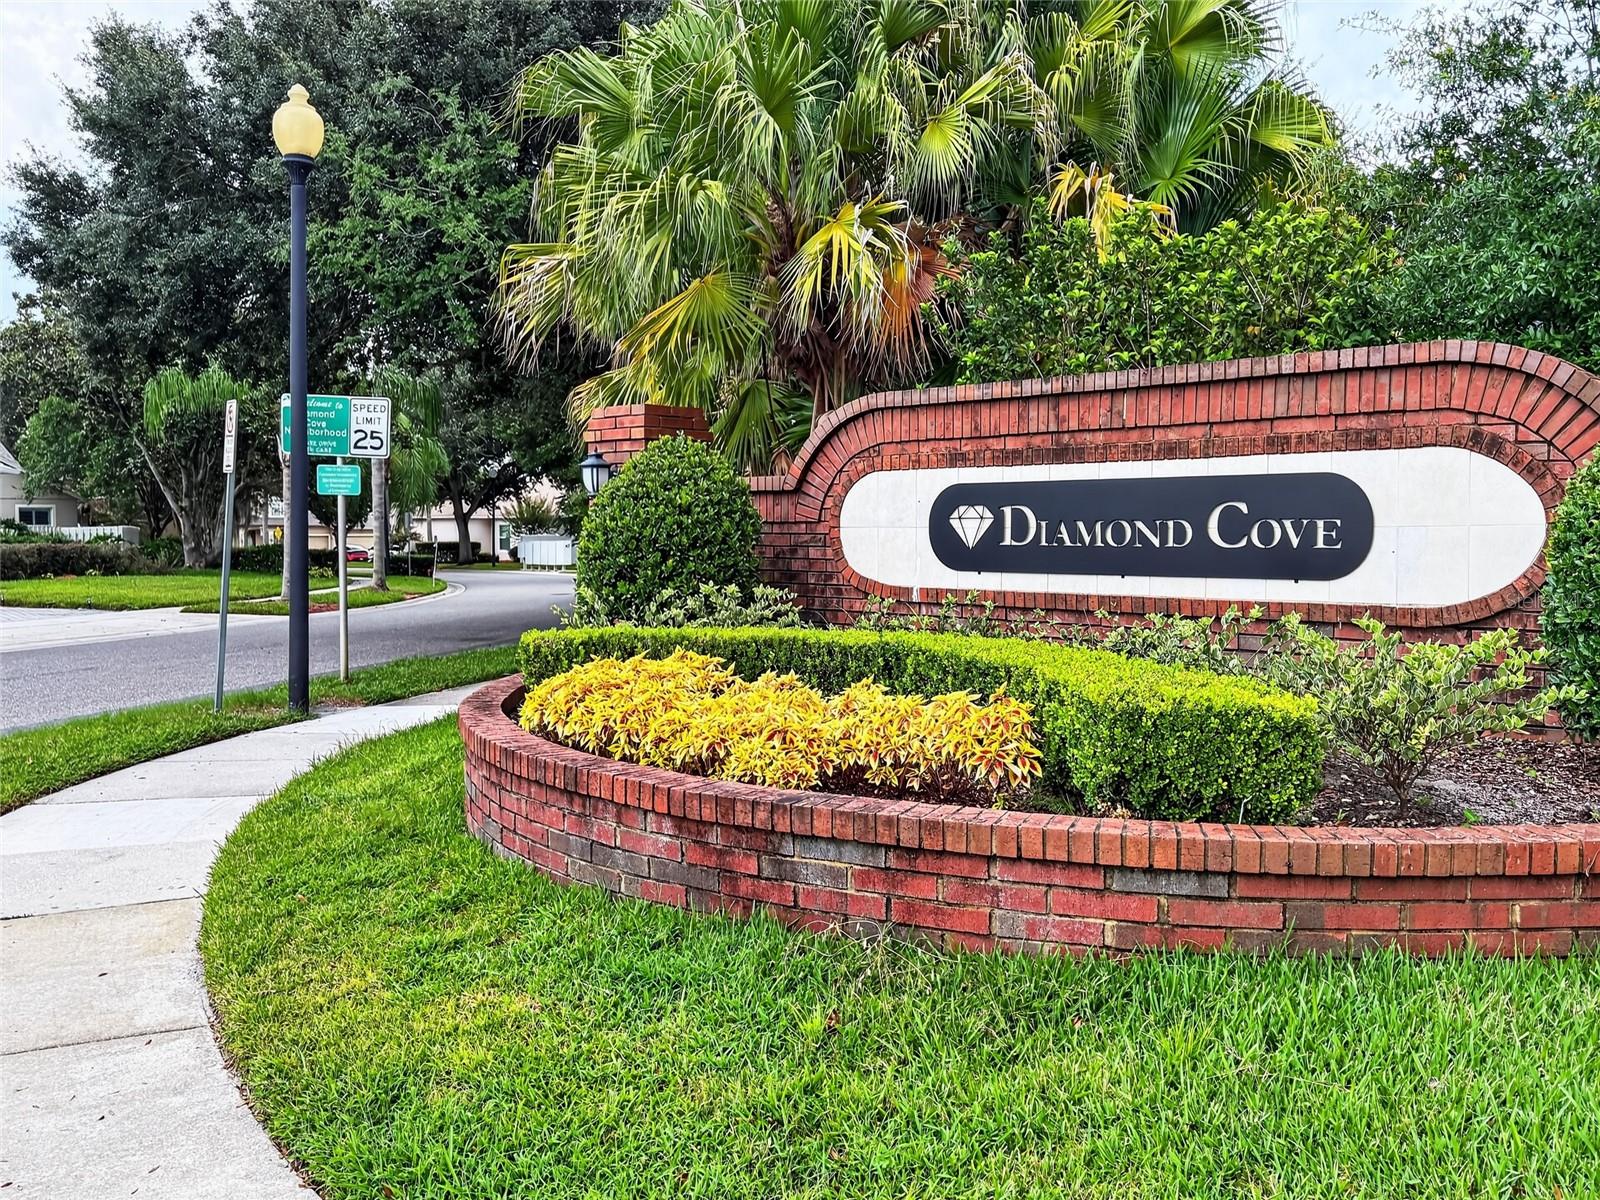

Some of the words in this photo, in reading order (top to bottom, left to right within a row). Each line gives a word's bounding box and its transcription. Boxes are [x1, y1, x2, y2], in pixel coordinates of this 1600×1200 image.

[335, 402, 344, 410] to
[353, 403, 386, 413] SPEED
[356, 416, 381, 425] LIMIT
[353, 429, 384, 450] 25
[1000, 504, 1193, 548] DIAMOND
[1207, 501, 1342, 550] COVE
